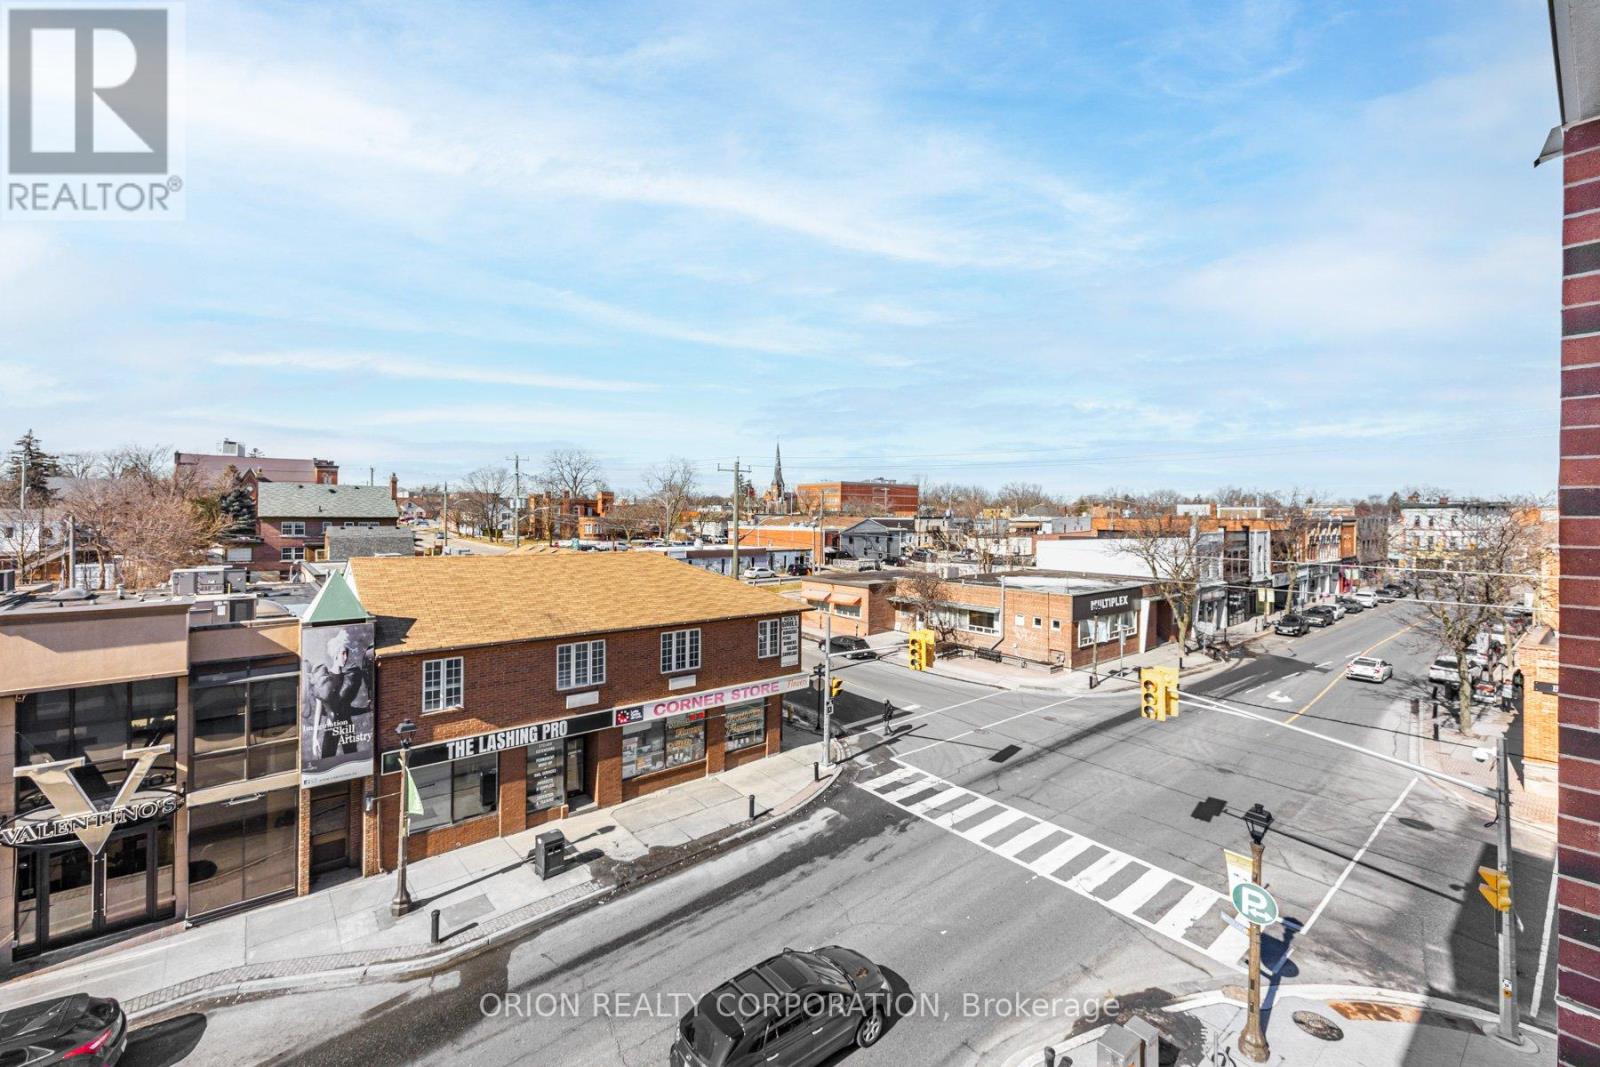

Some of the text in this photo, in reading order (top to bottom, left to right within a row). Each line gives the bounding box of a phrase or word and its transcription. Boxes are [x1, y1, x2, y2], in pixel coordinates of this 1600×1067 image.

[1090, 595, 1128, 611] MULTIPLEX
[653, 692, 724, 717] CORNER
[731, 681, 780, 701] STORE
[332, 724, 355, 736] Skill
[338, 732, 372, 745] Artistry
[446, 720, 568, 760] THE LASHING PRO
[1, 797, 177, 845] VALENTINO'S
[1242, 886, 1268, 916] P
